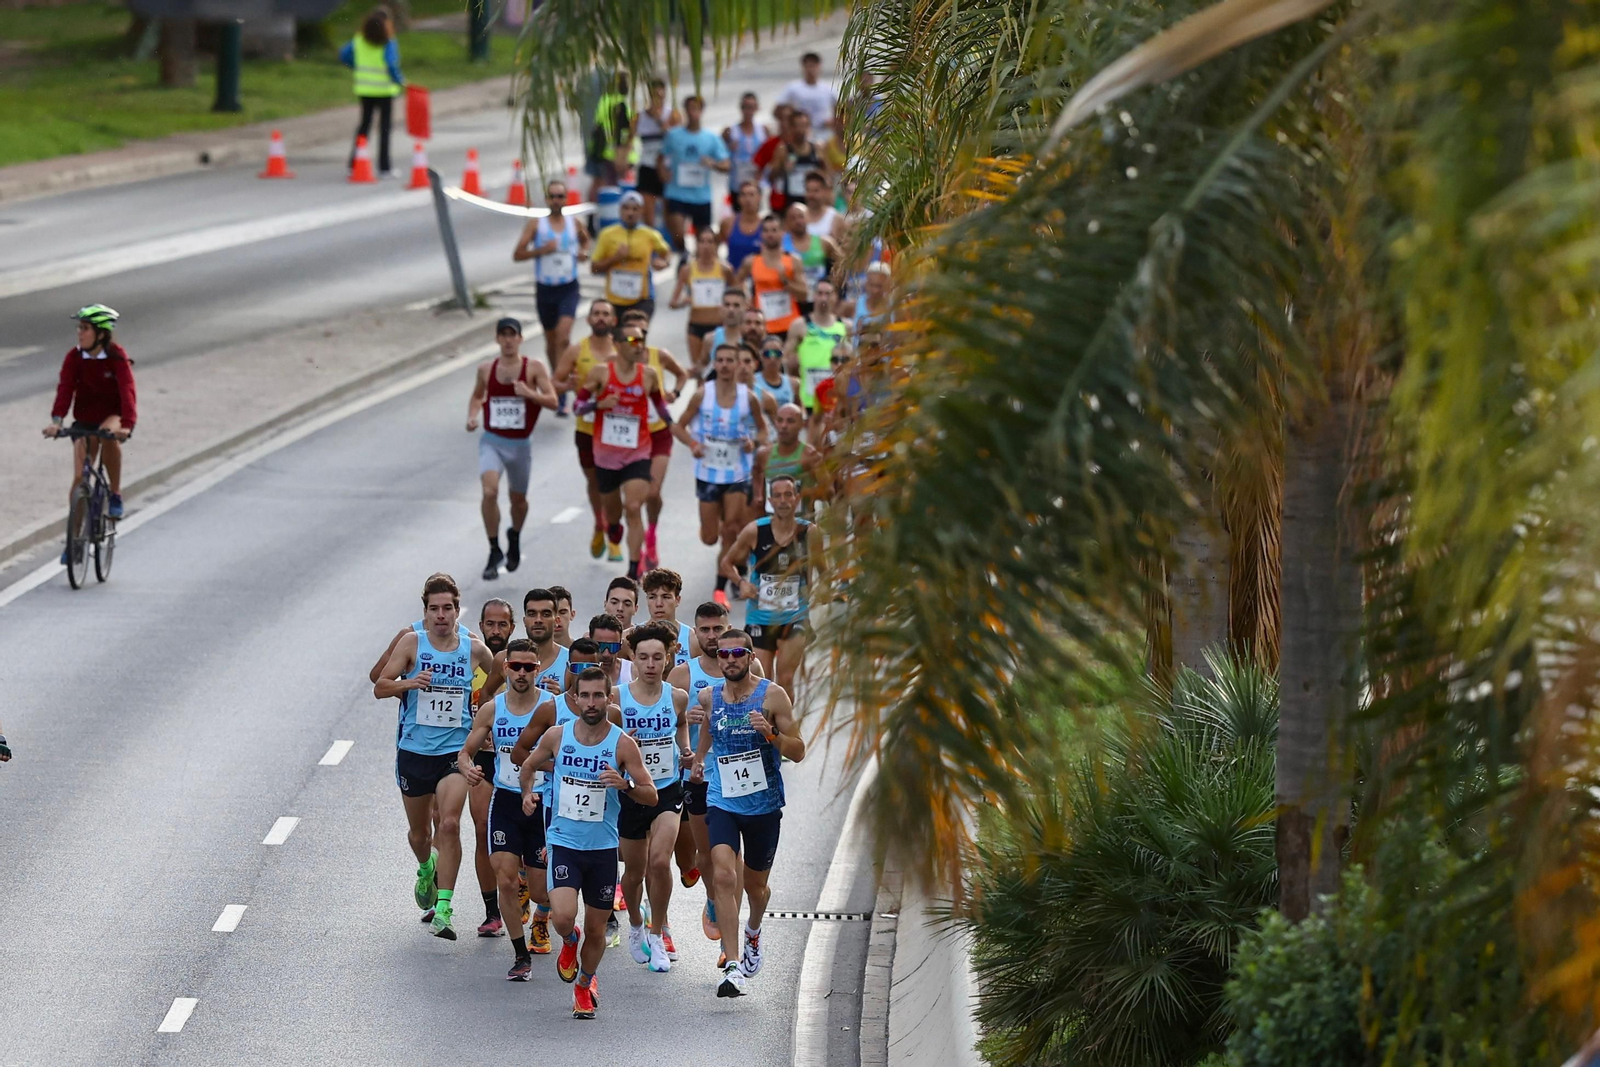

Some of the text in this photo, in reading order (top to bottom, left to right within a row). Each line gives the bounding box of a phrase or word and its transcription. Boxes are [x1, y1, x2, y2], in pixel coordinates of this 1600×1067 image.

[421, 661, 465, 678] nerja
[430, 699, 453, 711] 112
[625, 713, 671, 731] nerja
[497, 726, 525, 738] ner
[562, 754, 609, 773] nerja
[645, 753, 660, 765] 55
[718, 756, 729, 764] 43
[733, 767, 750, 781] 14
[562, 776, 575, 785] 43
[575, 793, 590, 806] 12
